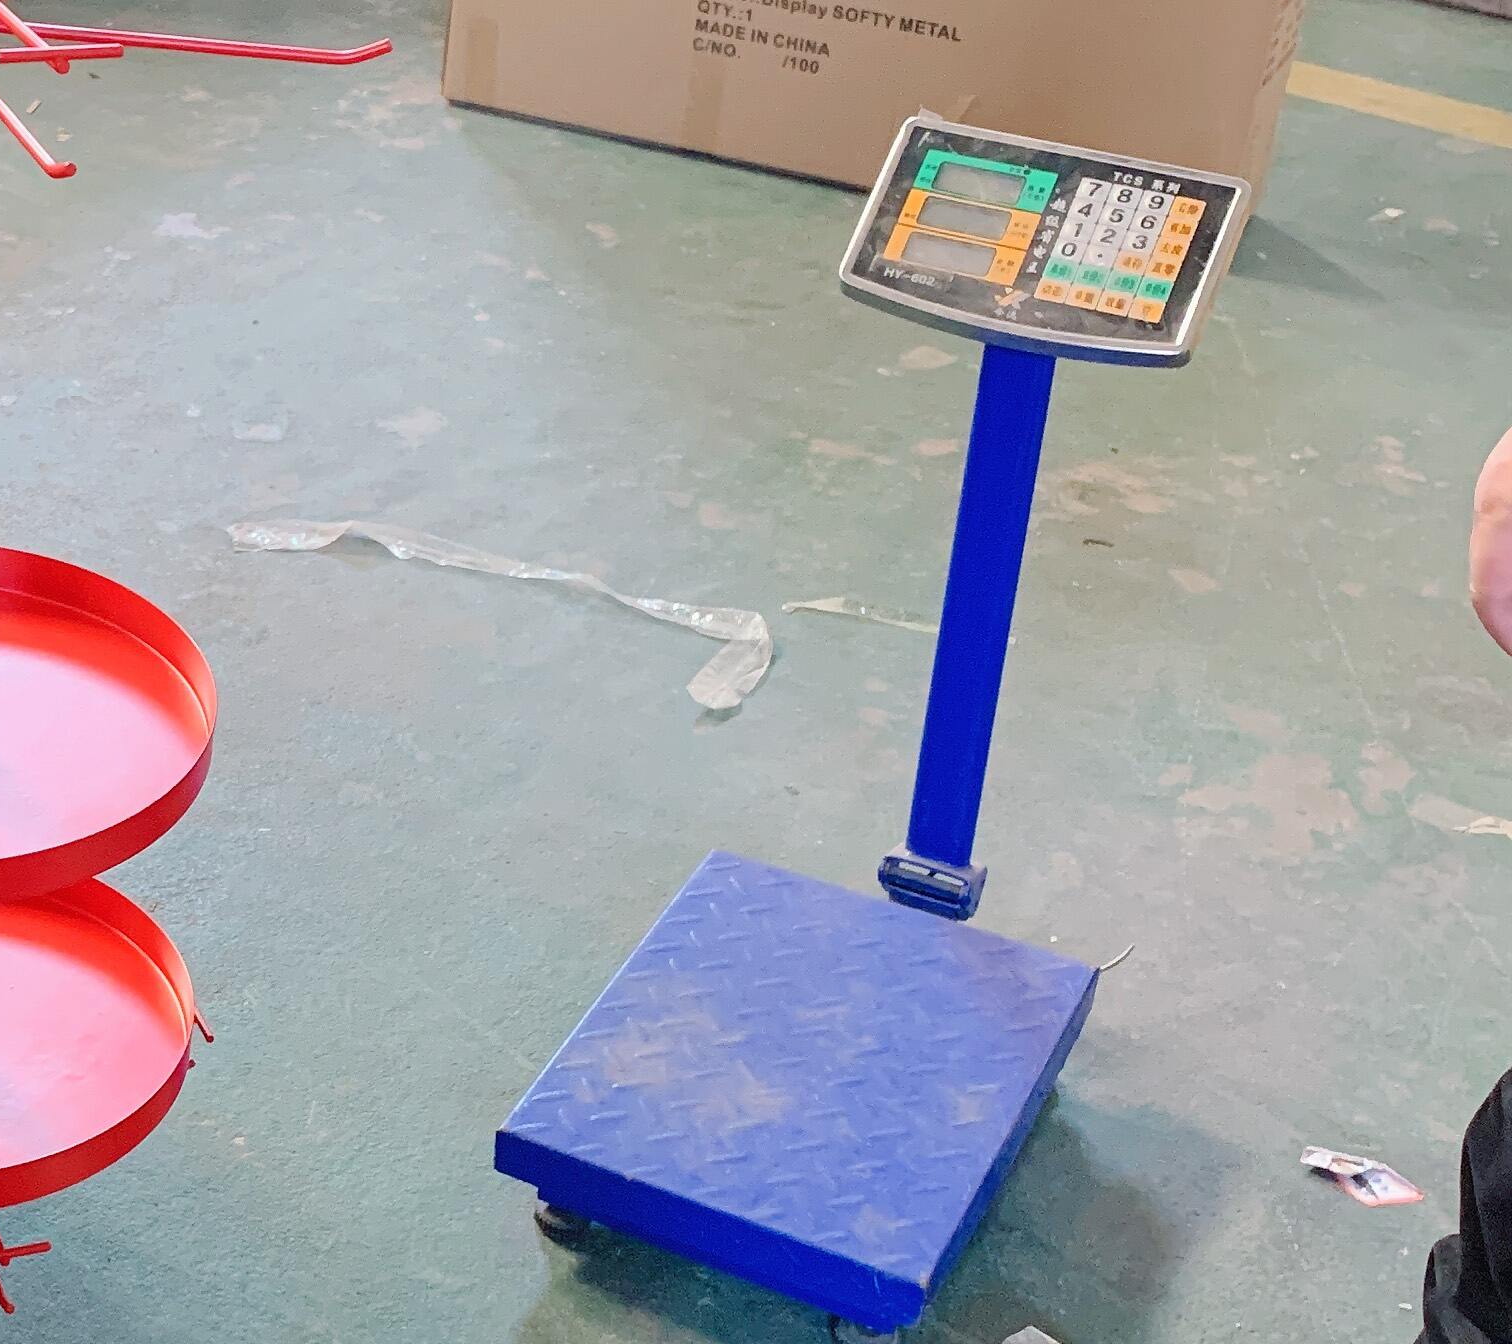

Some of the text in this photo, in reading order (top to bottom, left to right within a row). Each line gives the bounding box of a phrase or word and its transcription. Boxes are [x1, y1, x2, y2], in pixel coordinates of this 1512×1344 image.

[695, 19, 830, 56] MADE IN CHINA
[833, 6, 895, 28] SOFTY
[899, 18, 961, 42] METAL
[692, 38, 820, 74] C/NO. /100
[1090, 182, 1103, 197] 7
[1118, 189, 1132, 203] 8
[1148, 196, 1164, 209] 9
[1078, 203, 1092, 217] 4
[1109, 209, 1124, 223] 5
[1141, 216, 1157, 229] 6
[1061, 242, 1076, 256] 0
[1075, 223, 1083, 237] 1
[1100, 229, 1116, 243] 2
[1132, 236, 1148, 249] 3
